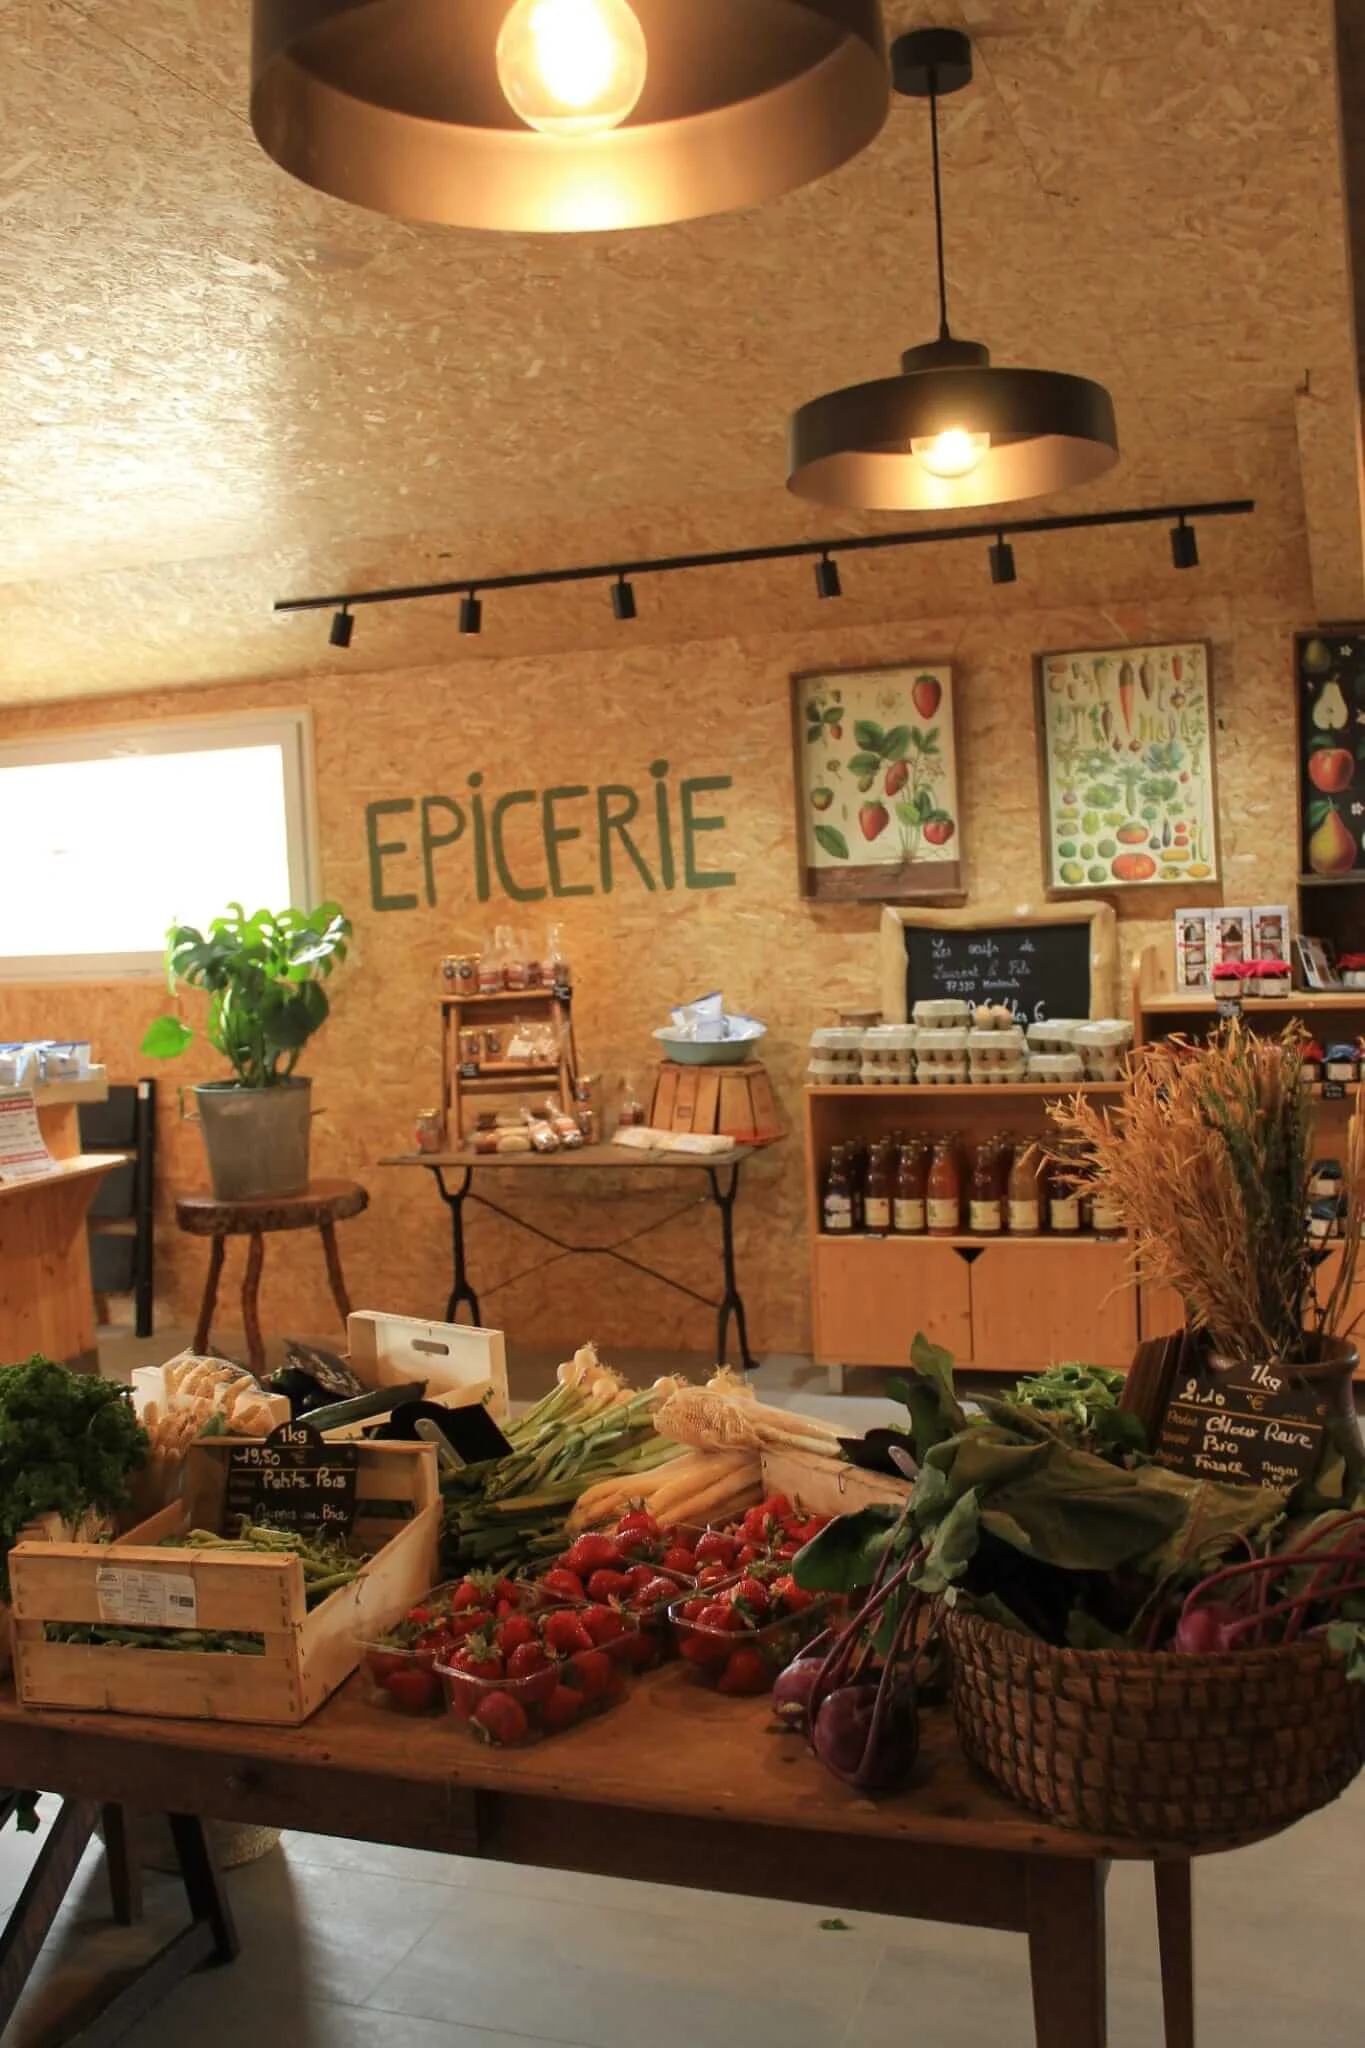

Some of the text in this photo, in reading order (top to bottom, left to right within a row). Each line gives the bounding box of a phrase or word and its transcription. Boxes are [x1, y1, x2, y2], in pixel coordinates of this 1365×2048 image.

[280, 1424, 307, 1444] 1kg
[1203, 1435, 1239, 1454] Bio
[1264, 1422, 1313, 1449] Rave
[316, 1466, 346, 1488] Pois
